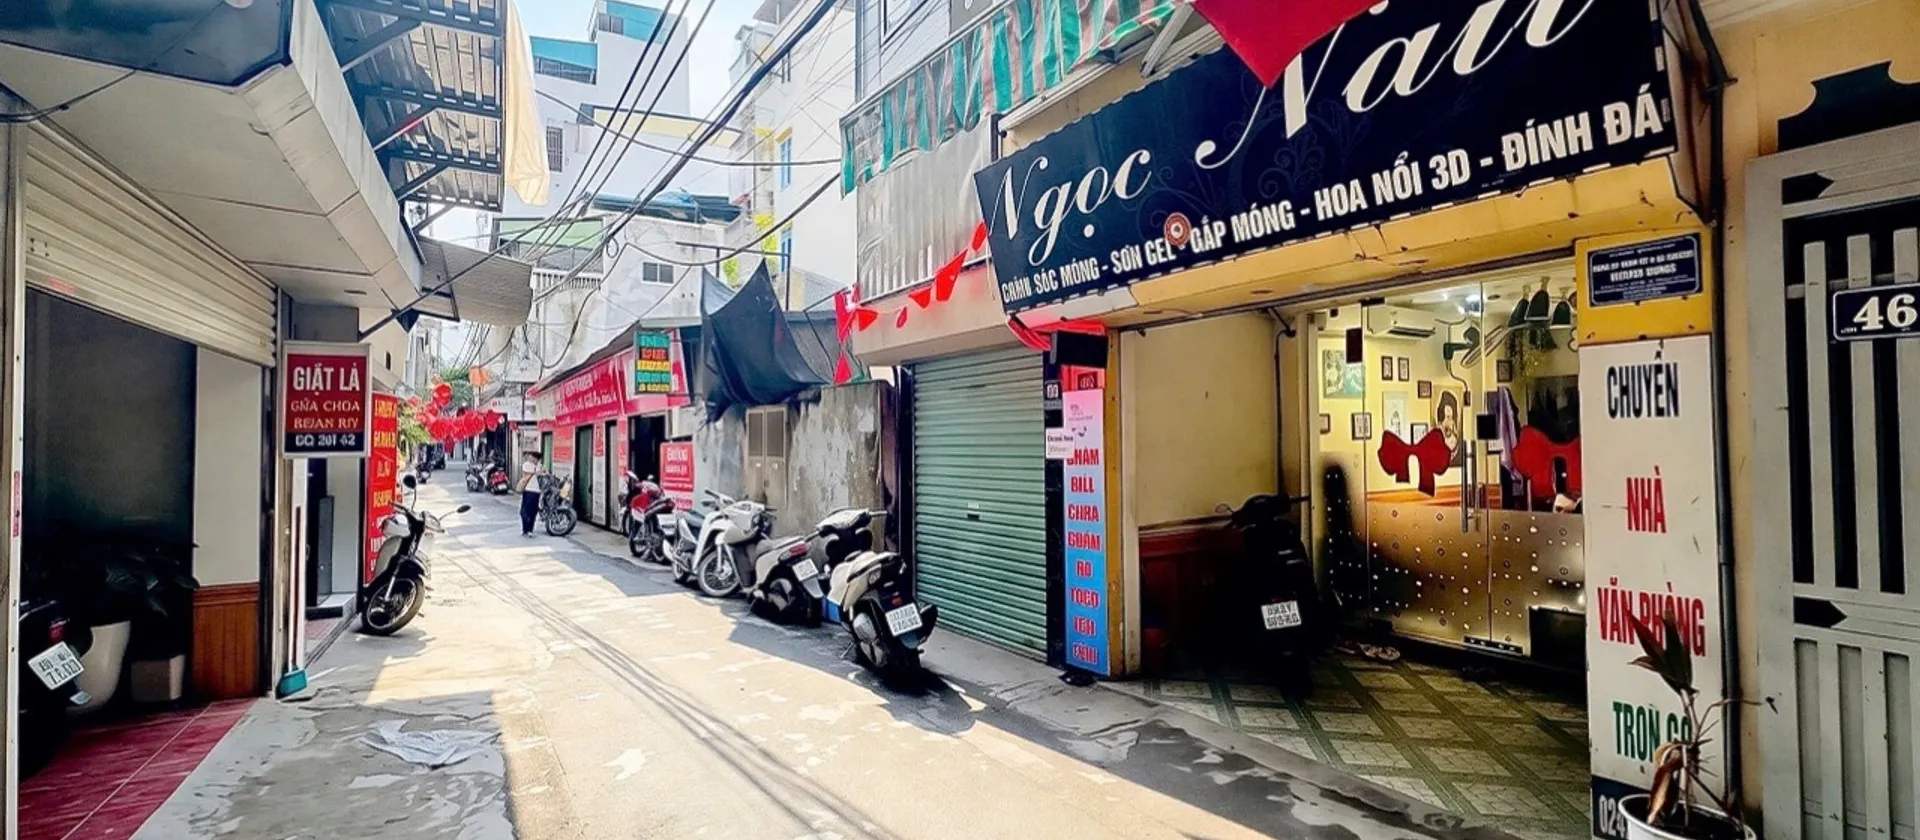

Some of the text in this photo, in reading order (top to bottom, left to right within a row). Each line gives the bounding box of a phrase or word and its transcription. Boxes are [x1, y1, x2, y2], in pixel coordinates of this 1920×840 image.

[989, 149, 1152, 266] Ngọc
[1059, 258, 1100, 288] MÓNG
[1230, 202, 1296, 243] MÓNG
[1314, 178, 1368, 221] HOA
[1429, 148, 1471, 190] 3D
[1501, 118, 1594, 172] ĐÍNH
[1603, 83, 1663, 146] ĐÁ
[1853, 294, 1918, 331] 46
[1626, 465, 1667, 533] NHÀ
[1597, 576, 1635, 645] VĂN
